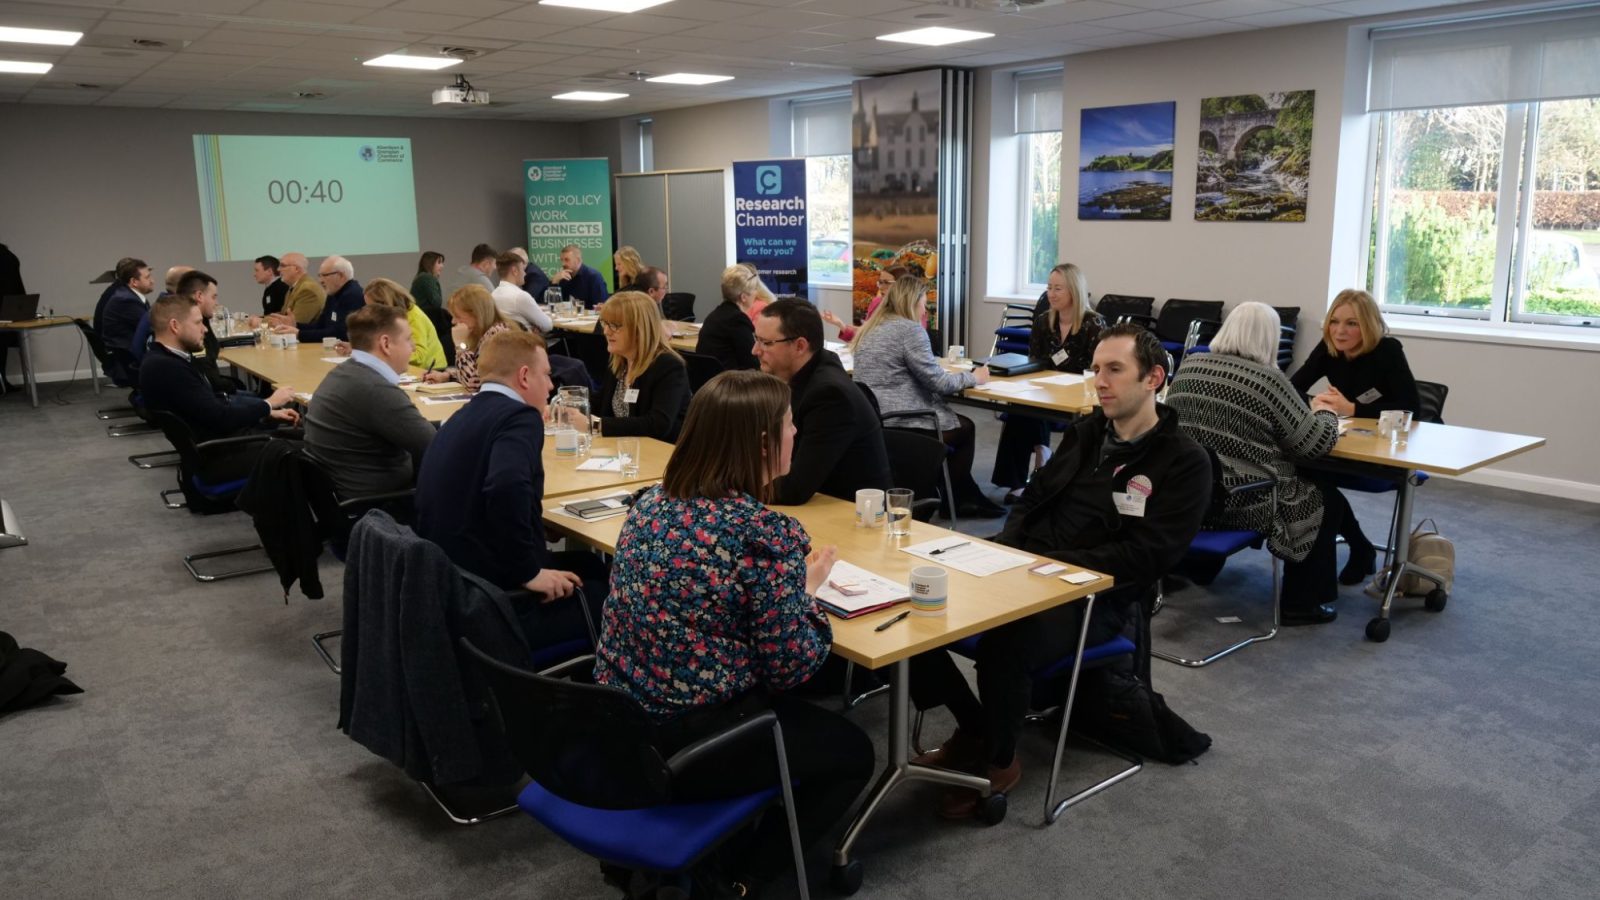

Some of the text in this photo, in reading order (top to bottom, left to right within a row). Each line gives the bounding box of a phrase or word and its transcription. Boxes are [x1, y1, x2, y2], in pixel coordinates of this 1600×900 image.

[268, 179, 343, 204] 00:40
[529, 194, 602, 206] OUR POLICY
[735, 196, 805, 210] Research
[530, 210, 568, 221] WORK
[736, 212, 805, 226] Chamber
[532, 224, 600, 235] CONNECTS
[744, 238, 766, 246] What
[747, 247, 795, 257] do for you?
